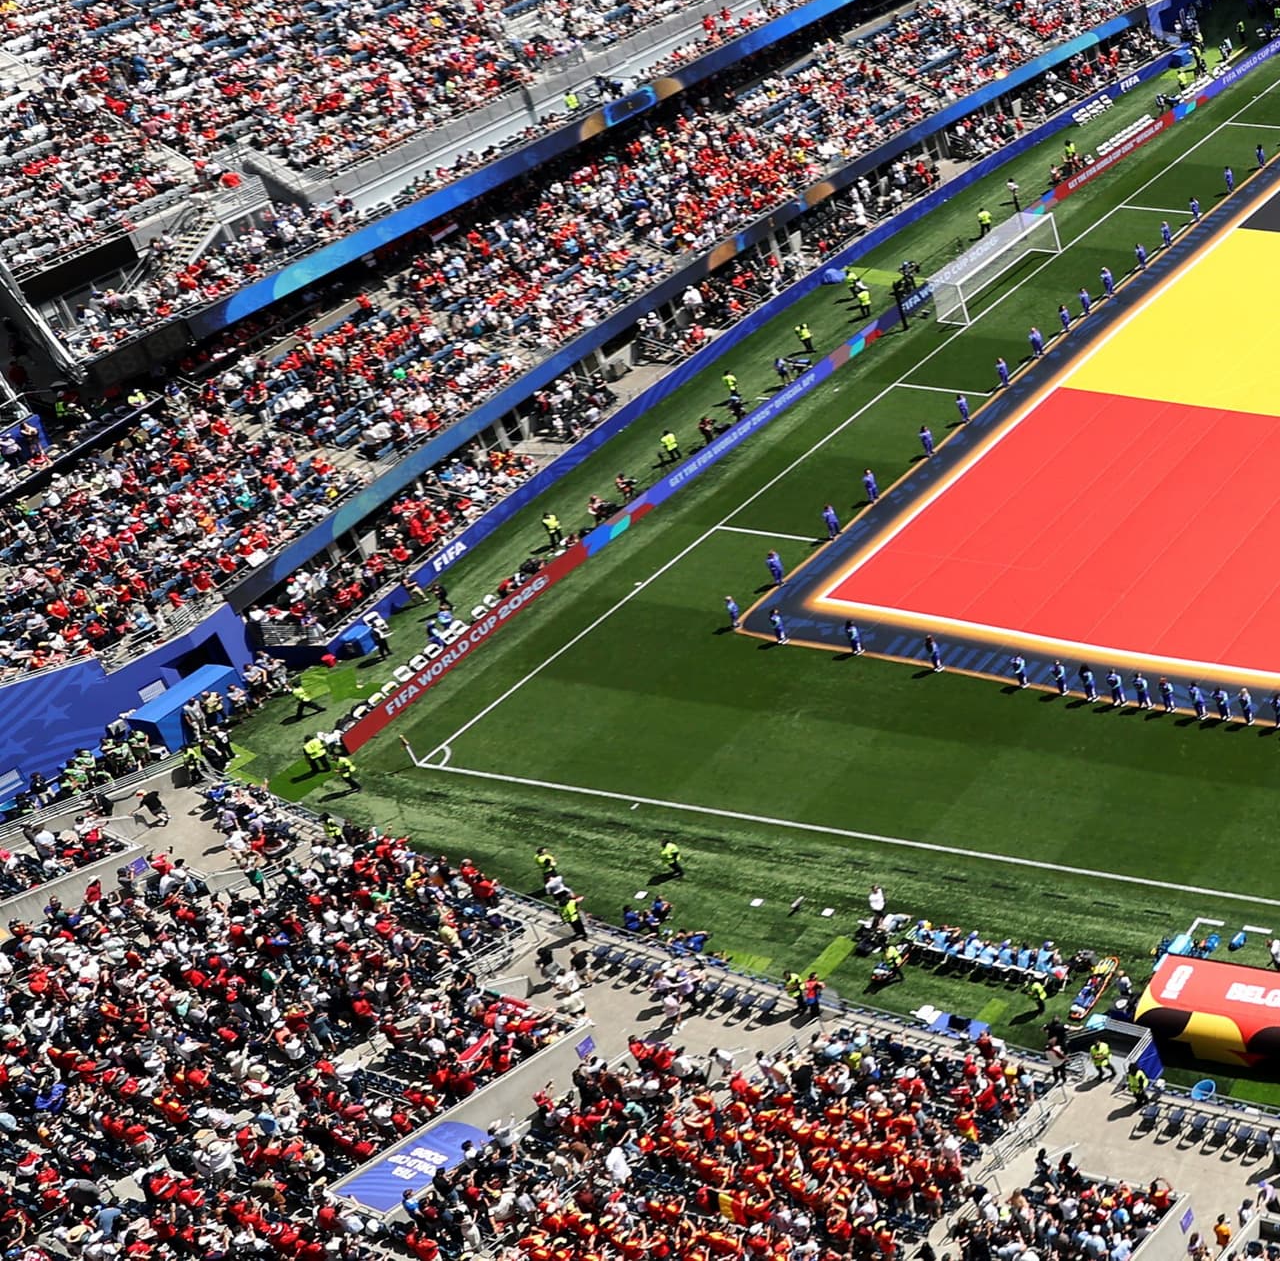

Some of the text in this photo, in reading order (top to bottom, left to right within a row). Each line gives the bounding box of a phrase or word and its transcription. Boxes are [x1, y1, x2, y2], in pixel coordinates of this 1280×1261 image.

[1120, 74, 1141, 92] FIFA
[1222, 71, 1238, 85] FIFA
[1236, 56, 1259, 76] WORLD
[1257, 47, 1271, 61] CUP
[432, 541, 468, 572] FIFA
[385, 575, 549, 716] FIFA WORLD CUP 2026
